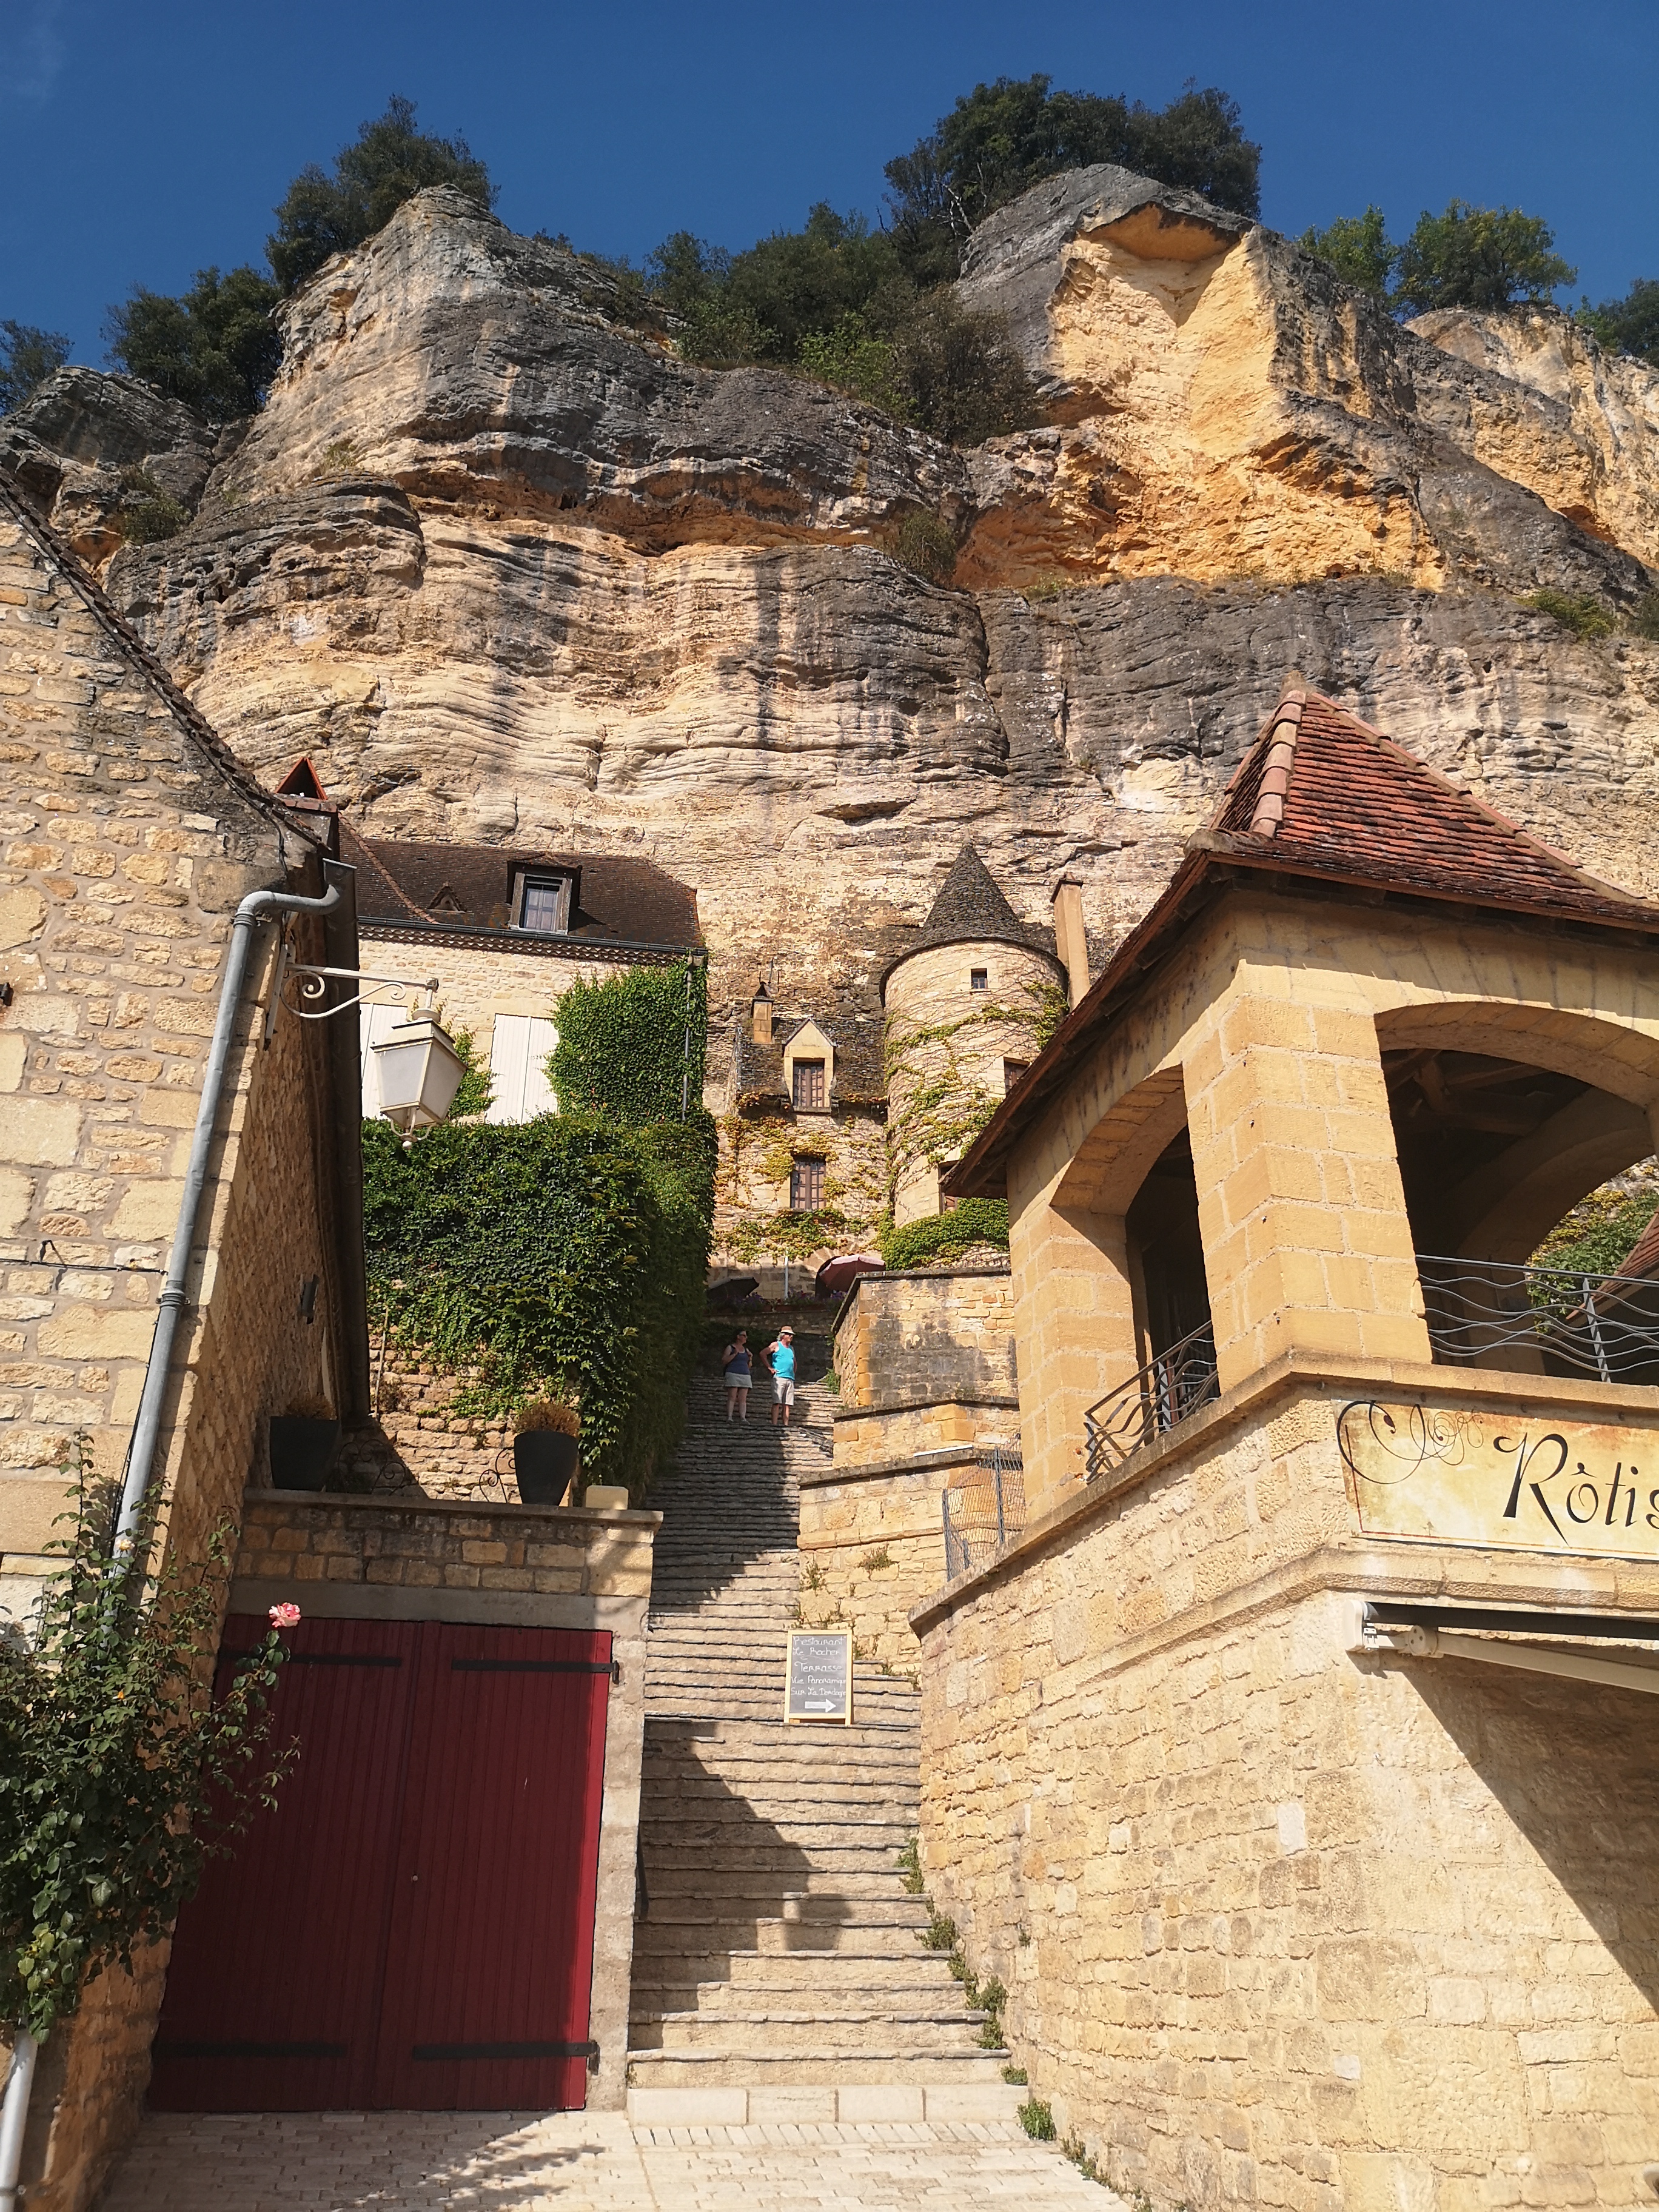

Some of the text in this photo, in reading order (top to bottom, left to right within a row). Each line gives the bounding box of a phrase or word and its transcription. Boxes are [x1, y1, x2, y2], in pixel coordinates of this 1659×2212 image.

[793, 1636, 844, 1645] Restaurant
[793, 1647, 840, 1655] Le Rocher
[794, 1661, 842, 1672] Terrasse
[791, 1687, 806, 1695] Sur
[808, 1686, 819, 1695] La
